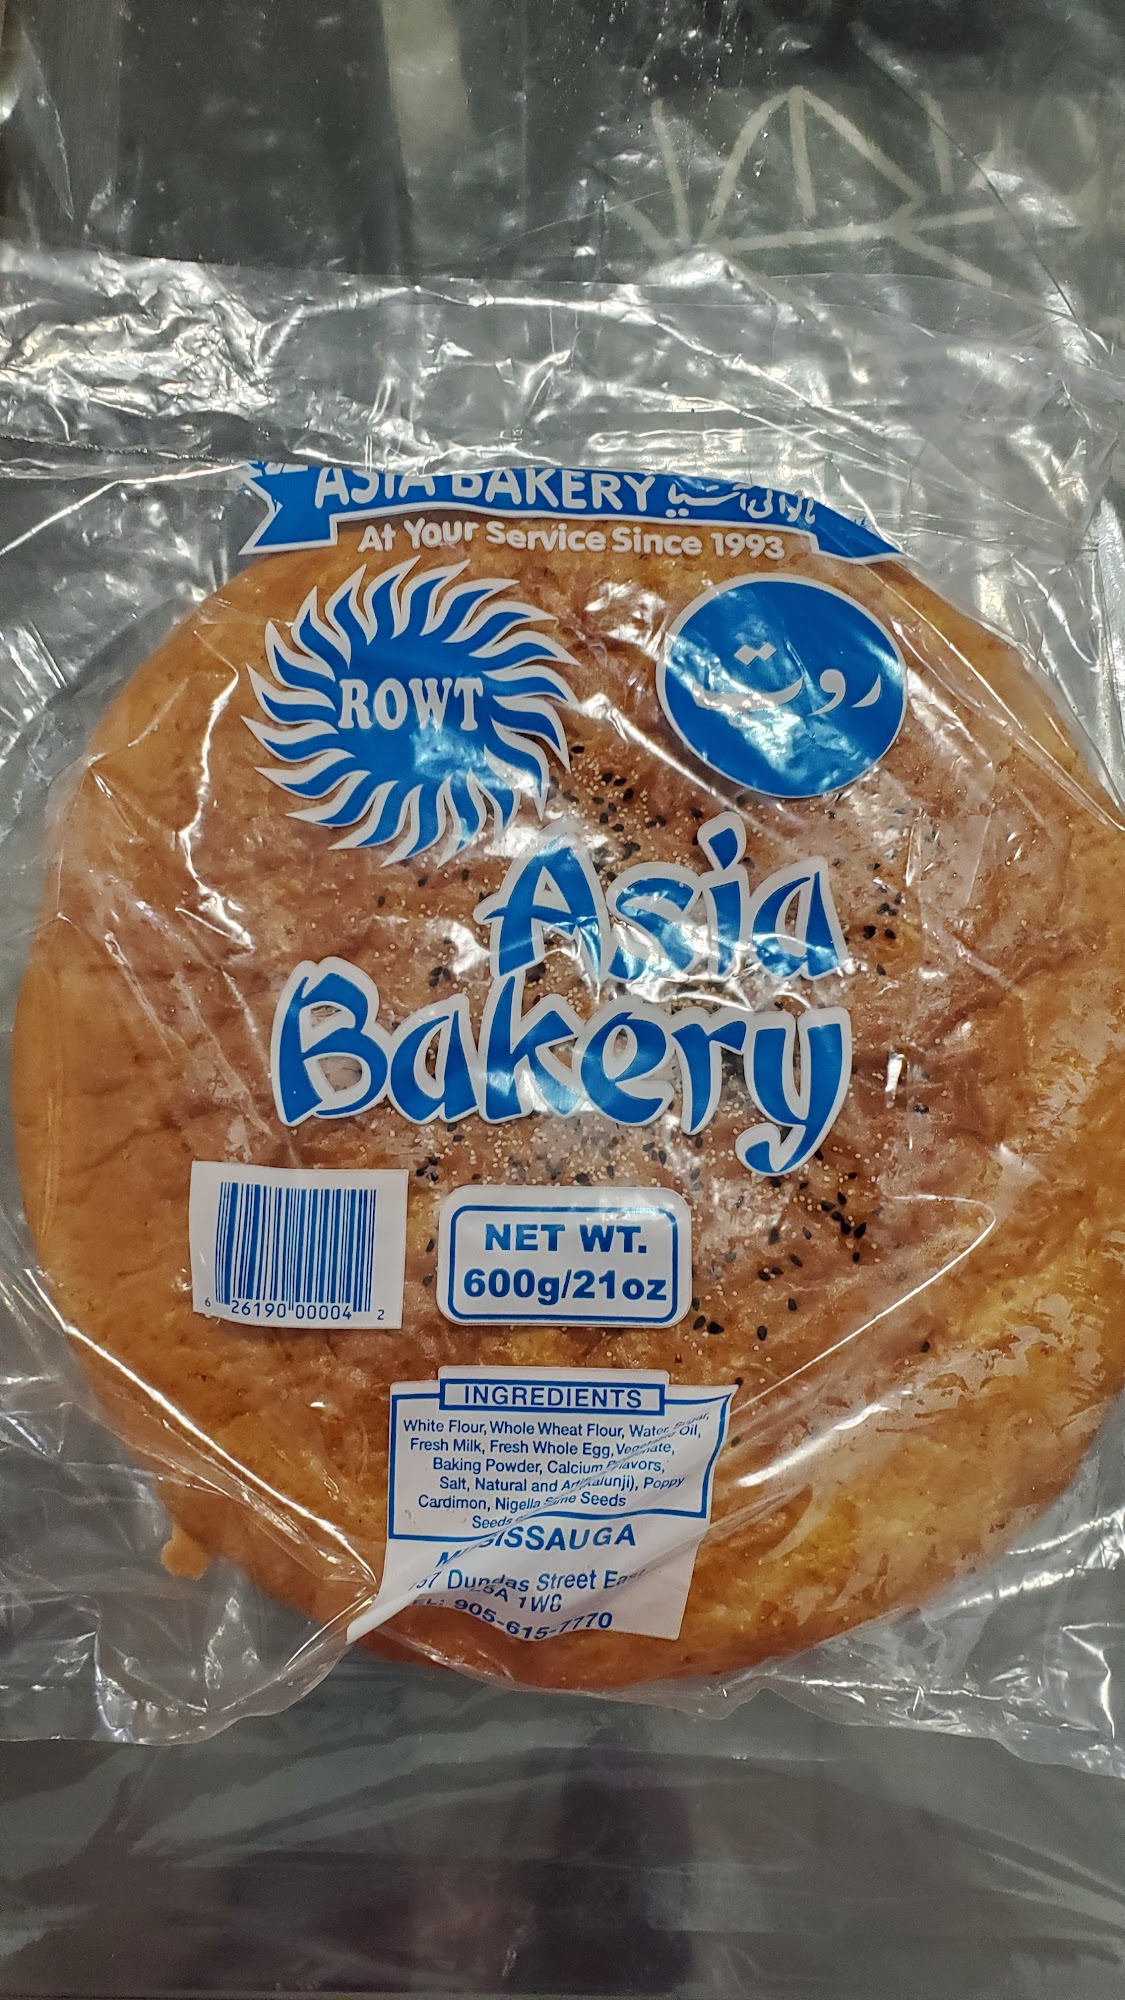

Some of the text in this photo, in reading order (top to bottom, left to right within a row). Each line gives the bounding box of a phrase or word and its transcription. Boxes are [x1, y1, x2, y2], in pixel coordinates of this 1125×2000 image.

[451, 467, 655, 511] BAKERY
[358, 517, 785, 560] At Your Service Since 1993
[338, 678, 484, 730] ROWT
[476, 818, 846, 980] Asia
[273, 960, 851, 1174] Bakery
[485, 1224, 648, 1254] NET WT.
[463, 1268, 668, 1306] 600g/21oz
[231, 1299, 287, 1319] 26190
[295, 1303, 352, 1321] 00004
[464, 1385, 642, 1408] INGREDIENTS
[403, 1419, 444, 1432] White
[448, 1420, 487, 1435] Flour,
[490, 1421, 535, 1434] Whole
[538, 1422, 582, 1436] Wheat
[587, 1424, 625, 1439] Flour,
[410, 1438, 448, 1451] Fresh
[453, 1439, 485, 1455] Milk,
[490, 1440, 528, 1453] Fresh
[533, 1441, 577, 1455] Whole
[582, 1442, 614, 1458] Egg,
[679, 1424, 701, 1439] Oil,
[433, 1457, 602, 1475] Baking Powder, Calcium
[418, 1494, 490, 1512] Cardimon,
[495, 1497, 540, 1513] Nigella
[643, 1477, 685, 1490] Poppy
[440, 1476, 470, 1492] Salt,
[475, 1477, 526, 1491] Natural
[531, 1479, 558, 1492] and
[580, 1492, 626, 1507] Seeds
[447, 1569, 530, 1592] Dundas
[536, 1569, 597, 1591] Street
